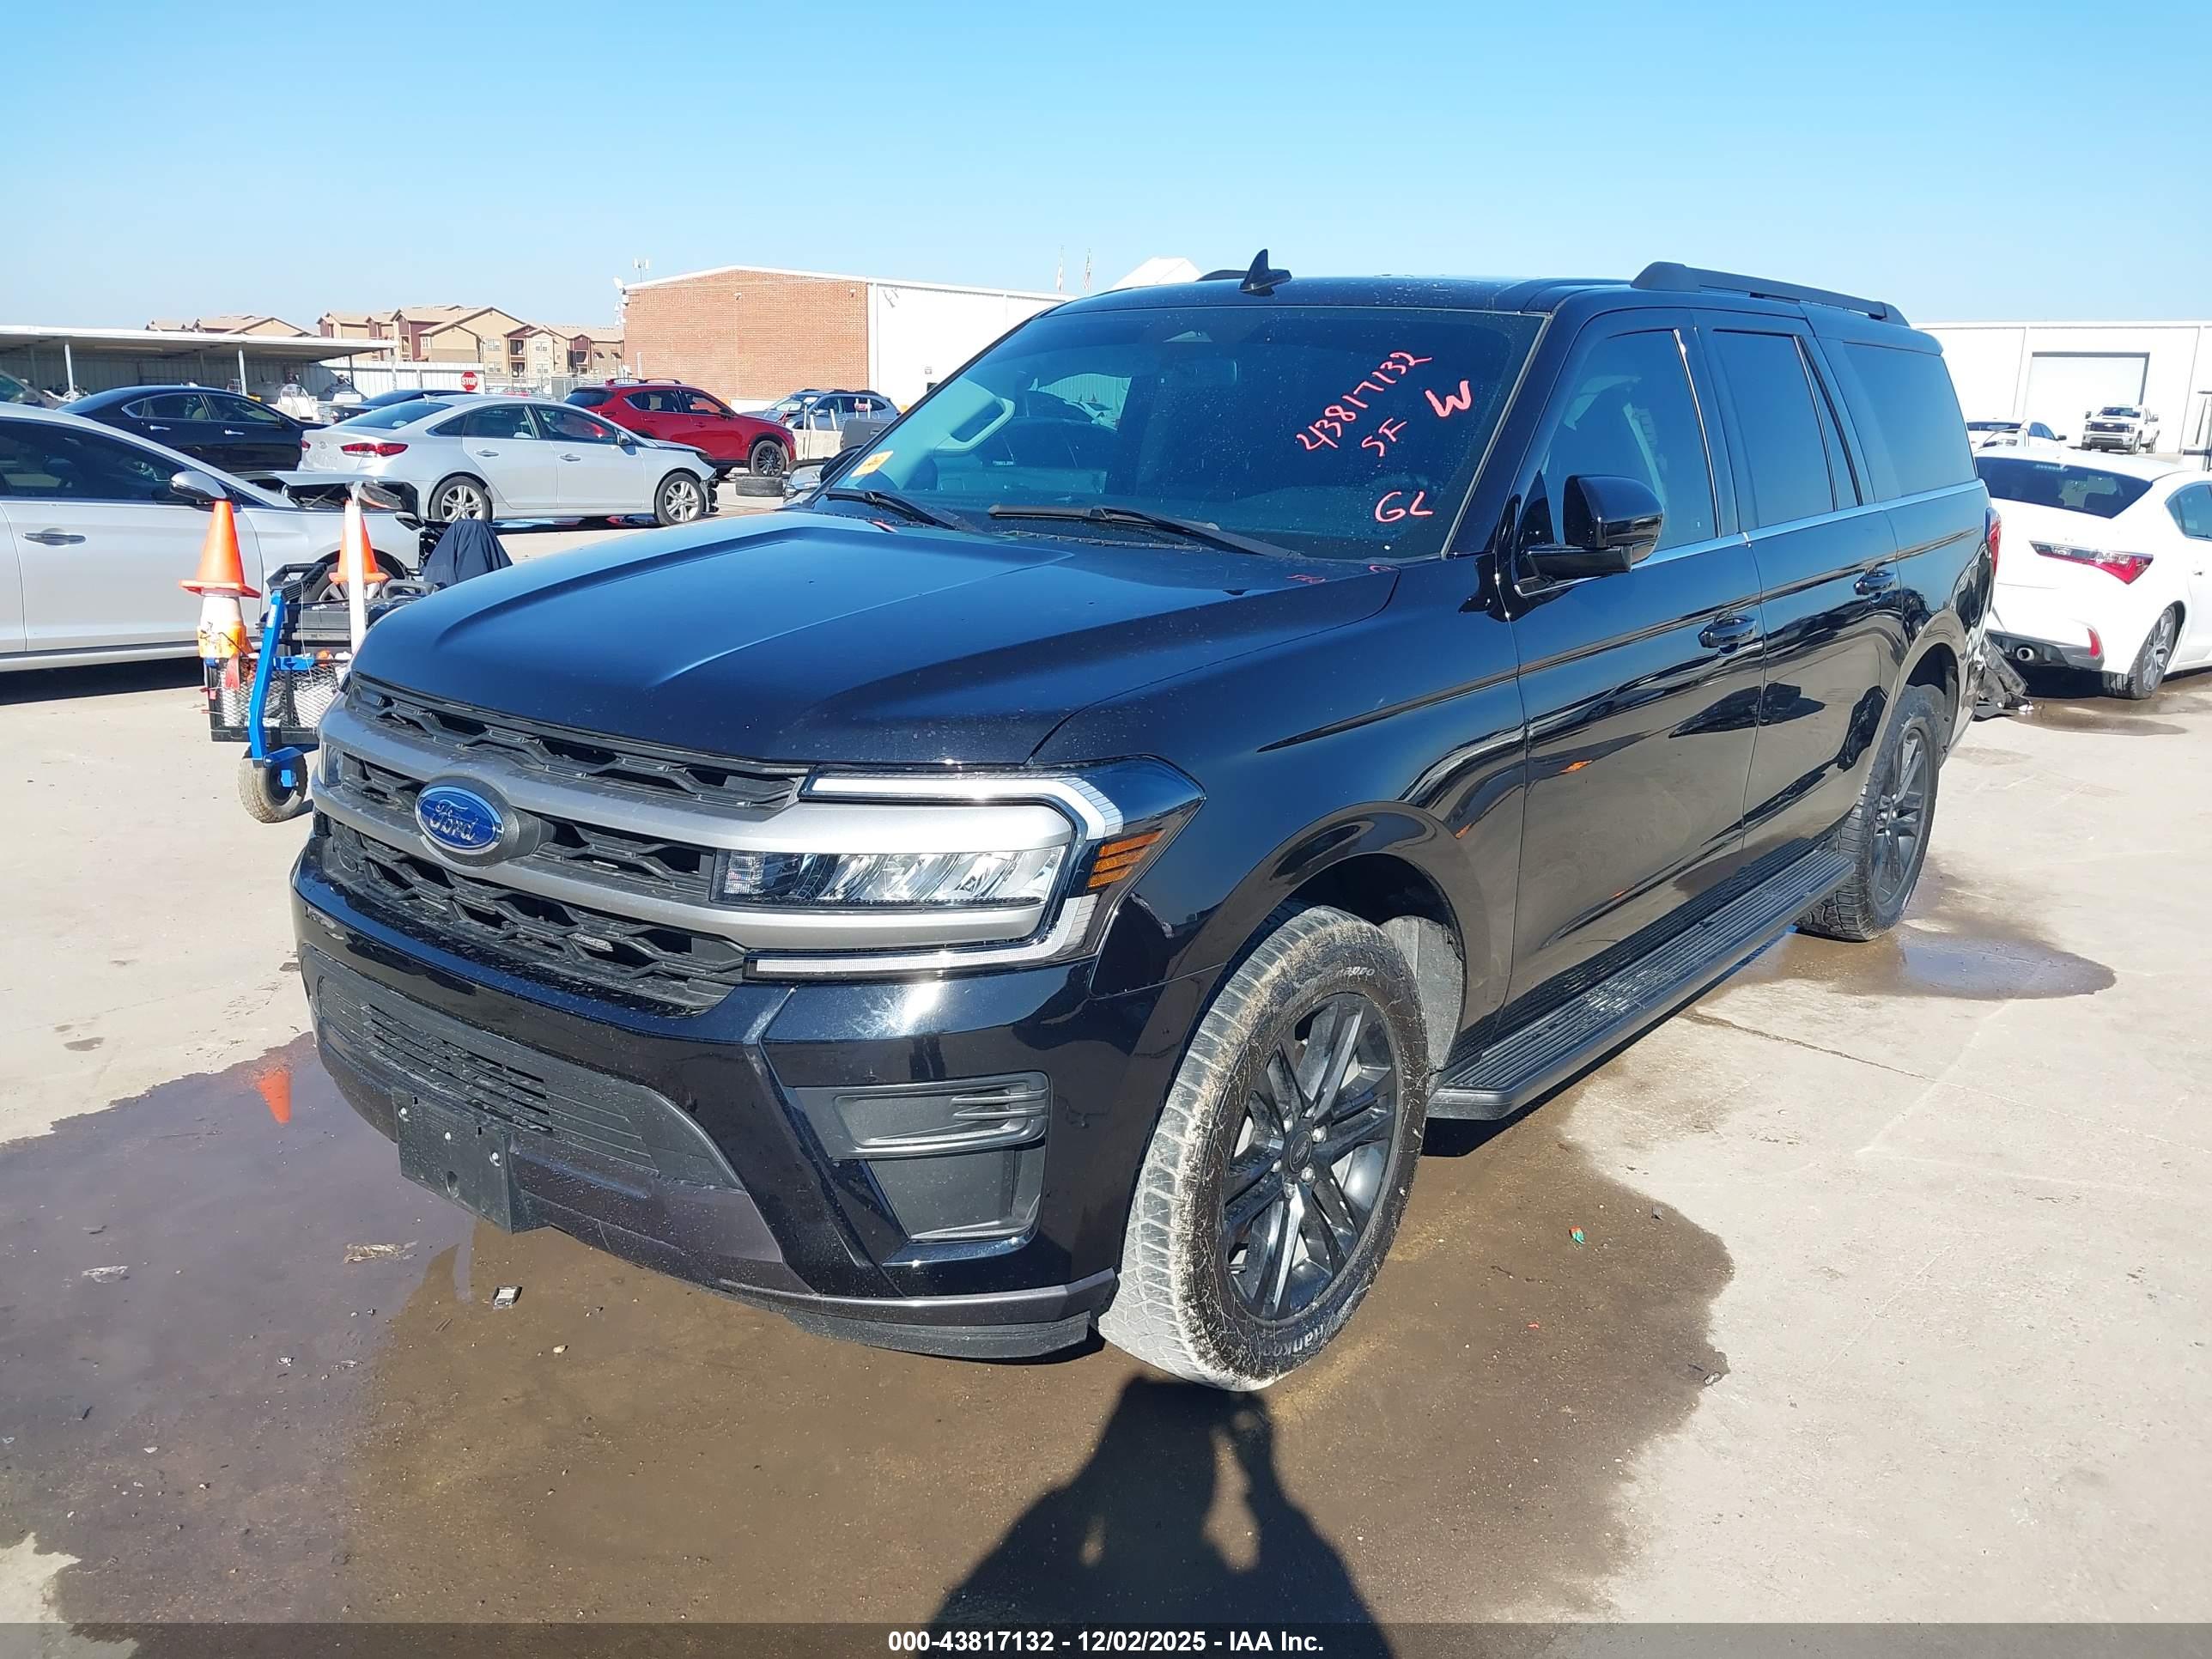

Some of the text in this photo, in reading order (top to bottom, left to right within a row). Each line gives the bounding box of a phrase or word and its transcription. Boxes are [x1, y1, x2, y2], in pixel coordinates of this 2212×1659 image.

[461, 377, 477, 386] STOP
[1297, 350, 1432, 450] 43817132
[1425, 380, 1473, 417] W
[430, 799, 479, 841] Ford
[1260, 1323, 1324, 1358] Hankoo
